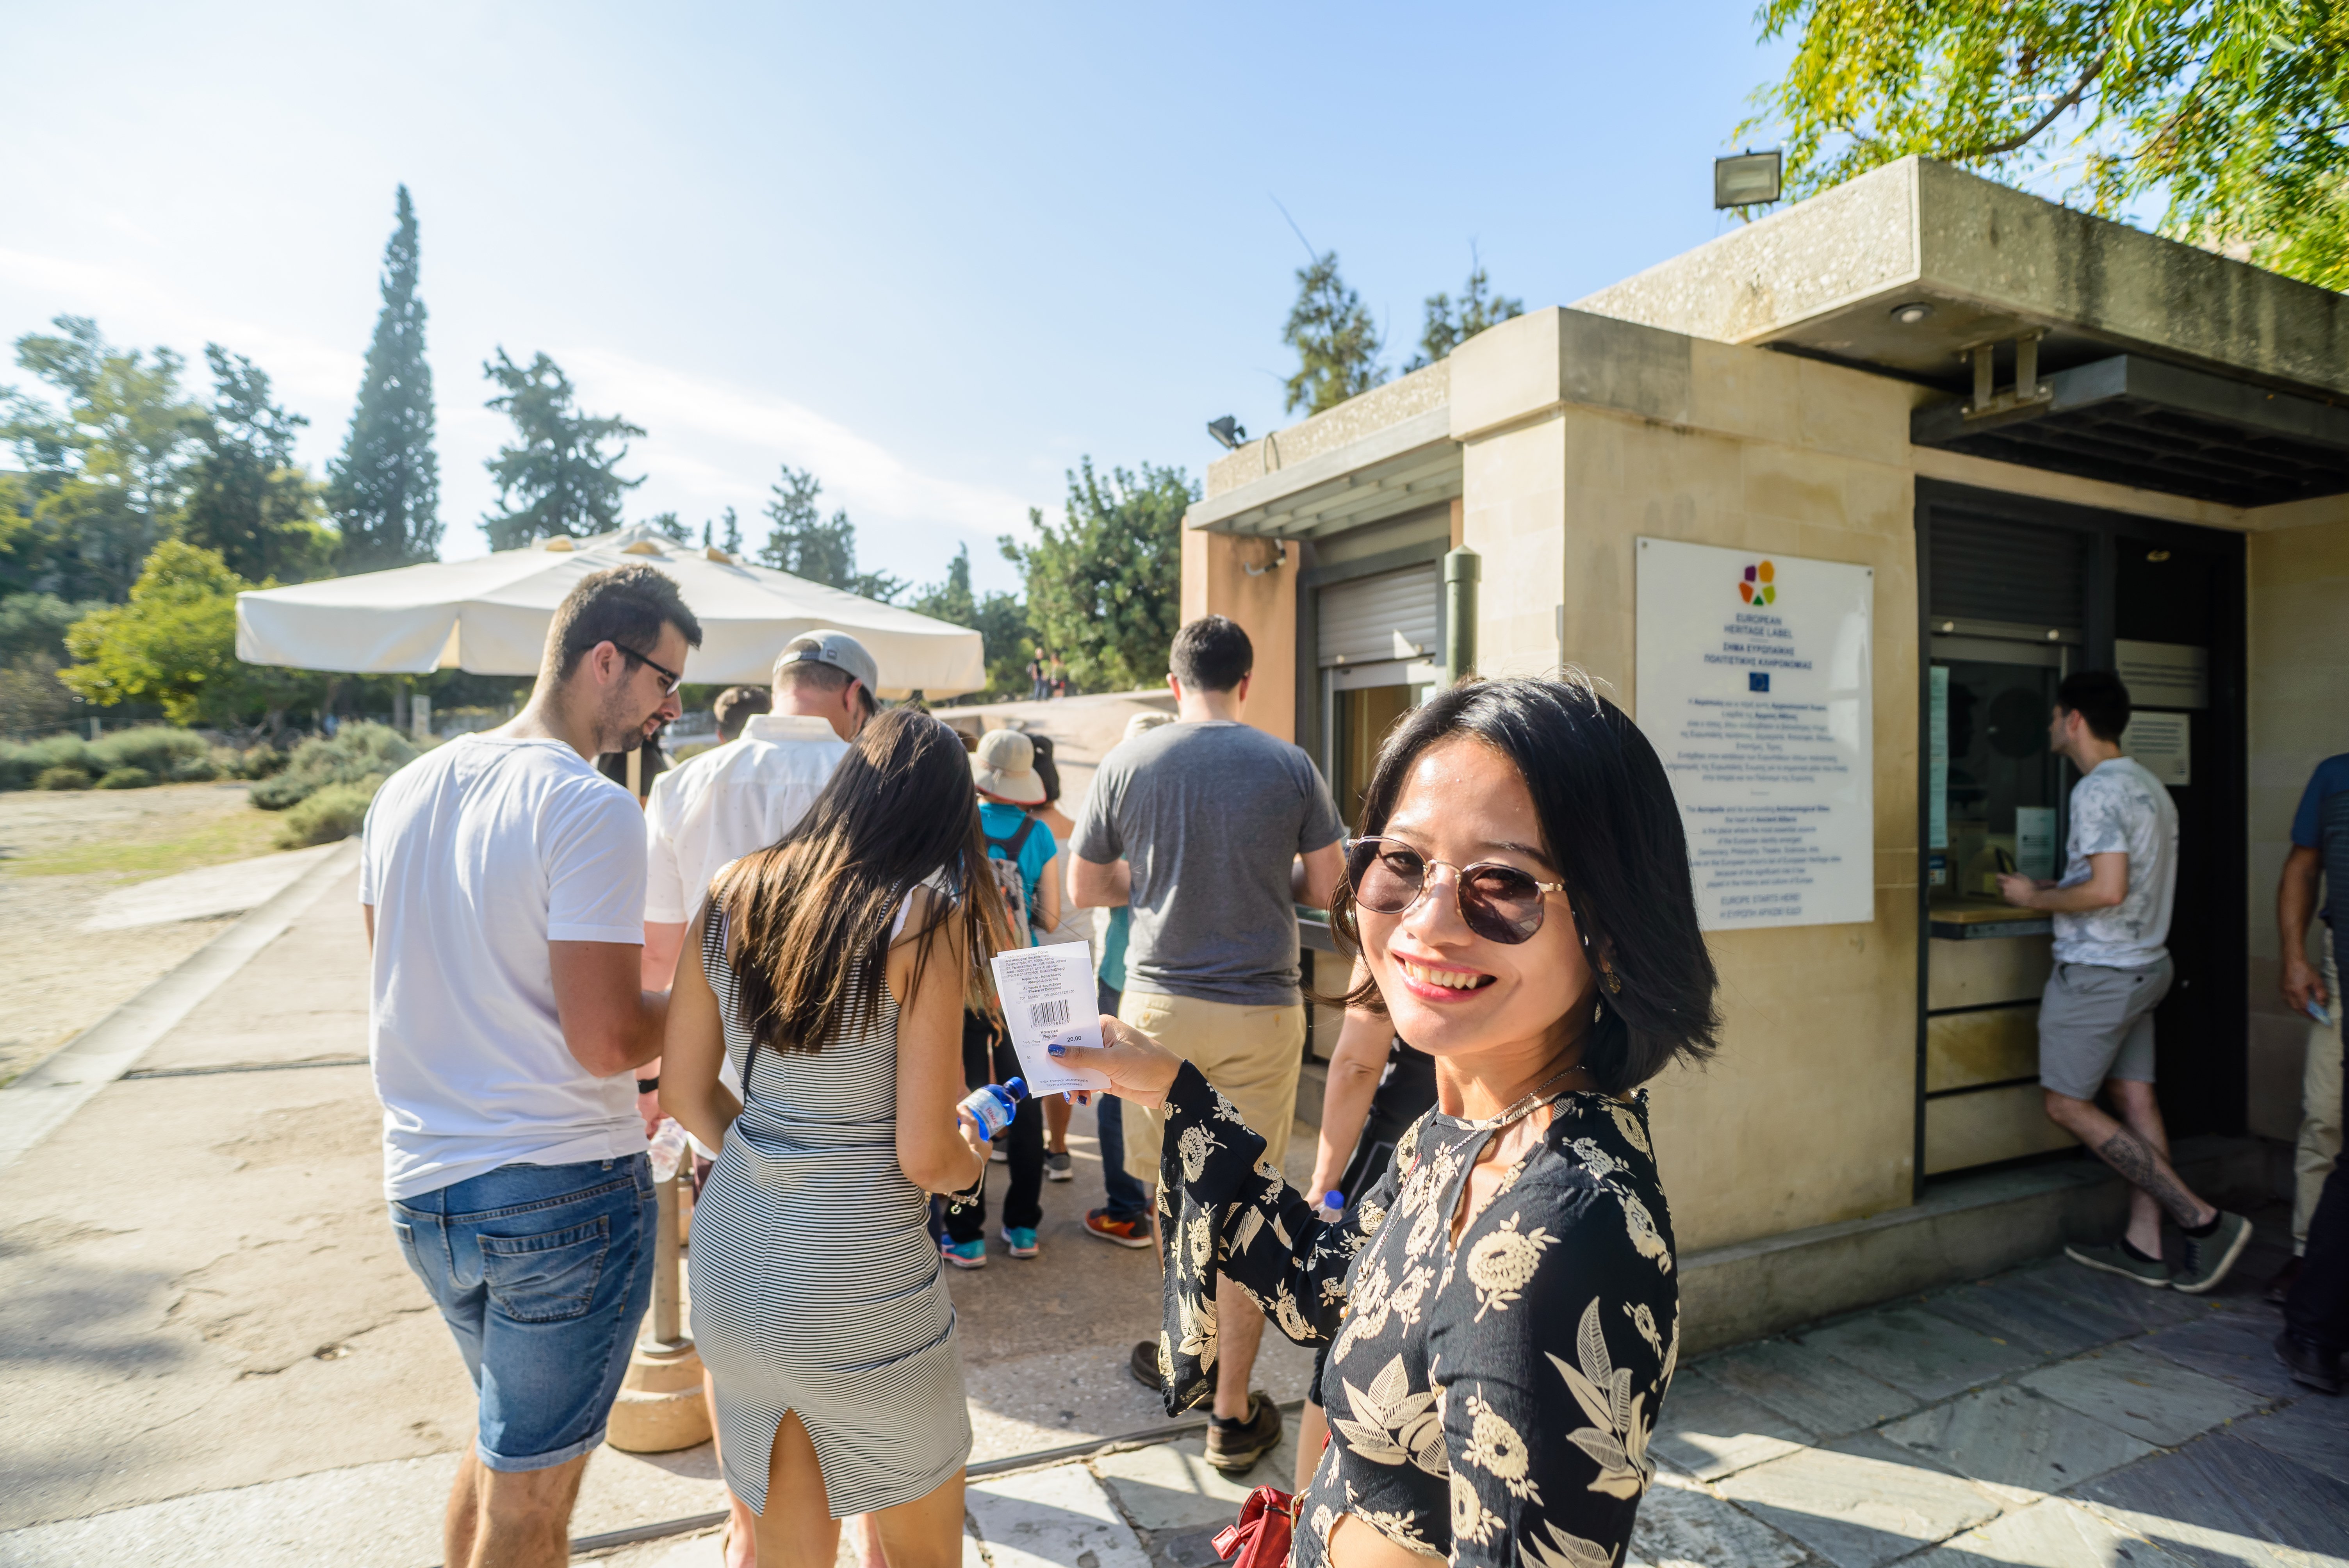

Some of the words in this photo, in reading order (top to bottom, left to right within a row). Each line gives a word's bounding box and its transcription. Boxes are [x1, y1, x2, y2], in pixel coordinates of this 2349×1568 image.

[1736, 612, 1782, 625] EUROPEAN
[1724, 624, 1764, 637] HERITAGE
[1766, 628, 1793, 639] LABEL
